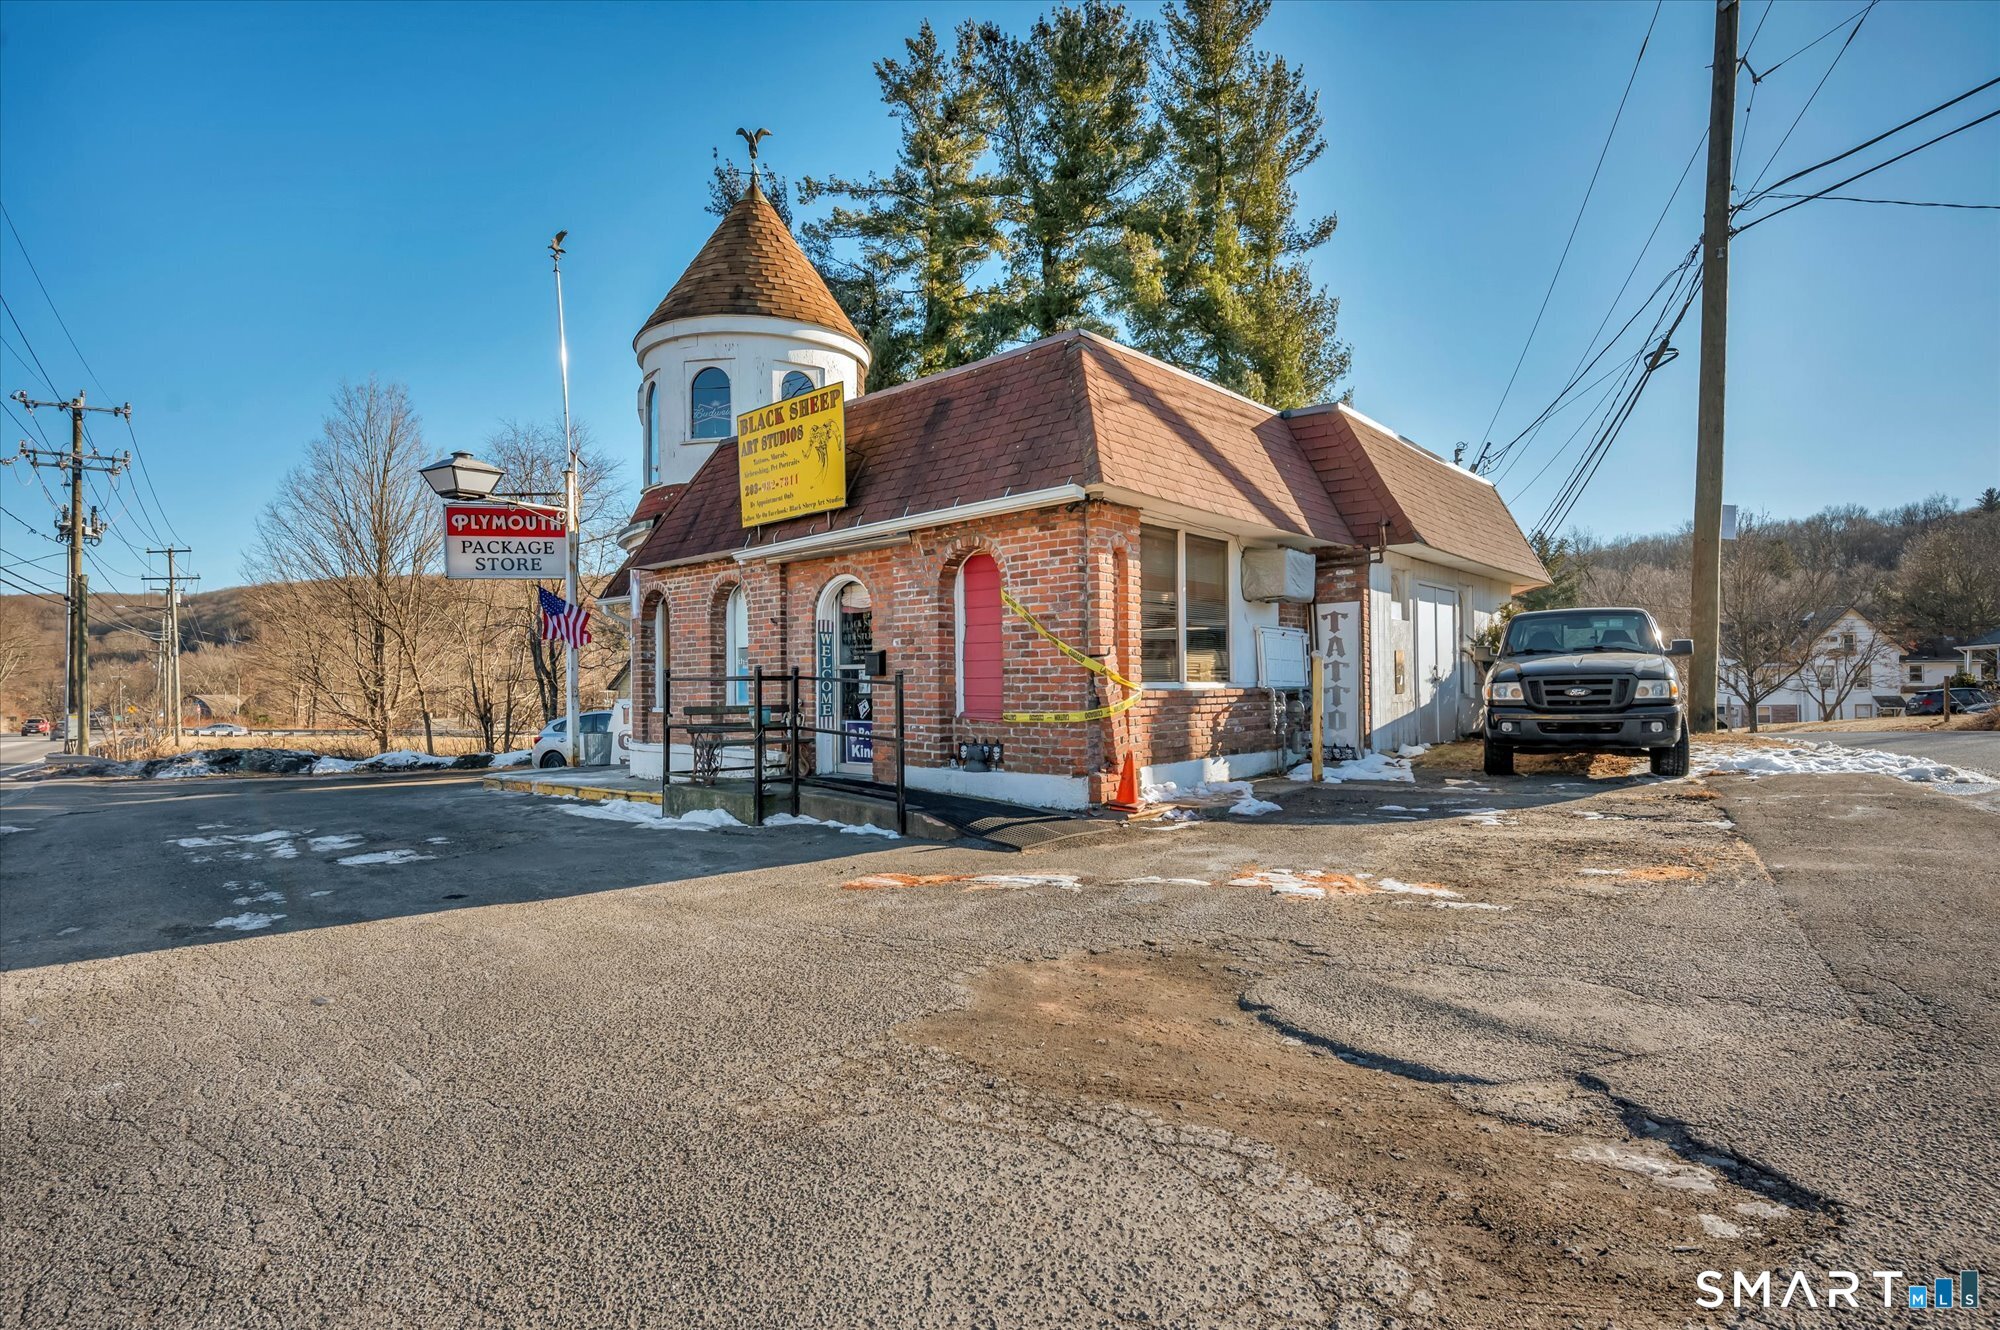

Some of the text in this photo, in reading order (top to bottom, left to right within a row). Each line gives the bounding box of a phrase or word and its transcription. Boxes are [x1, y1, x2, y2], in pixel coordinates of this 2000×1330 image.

[740, 389, 841, 437] BLACK SHEEP
[741, 424, 804, 458] ART STUDIOS
[451, 514, 562, 532] PLYMOUTH
[461, 540, 555, 555] PACKAGE
[475, 557, 542, 571] STORE
[819, 633, 833, 716] WELCOME
[1569, 688, 1586, 696] Ford
